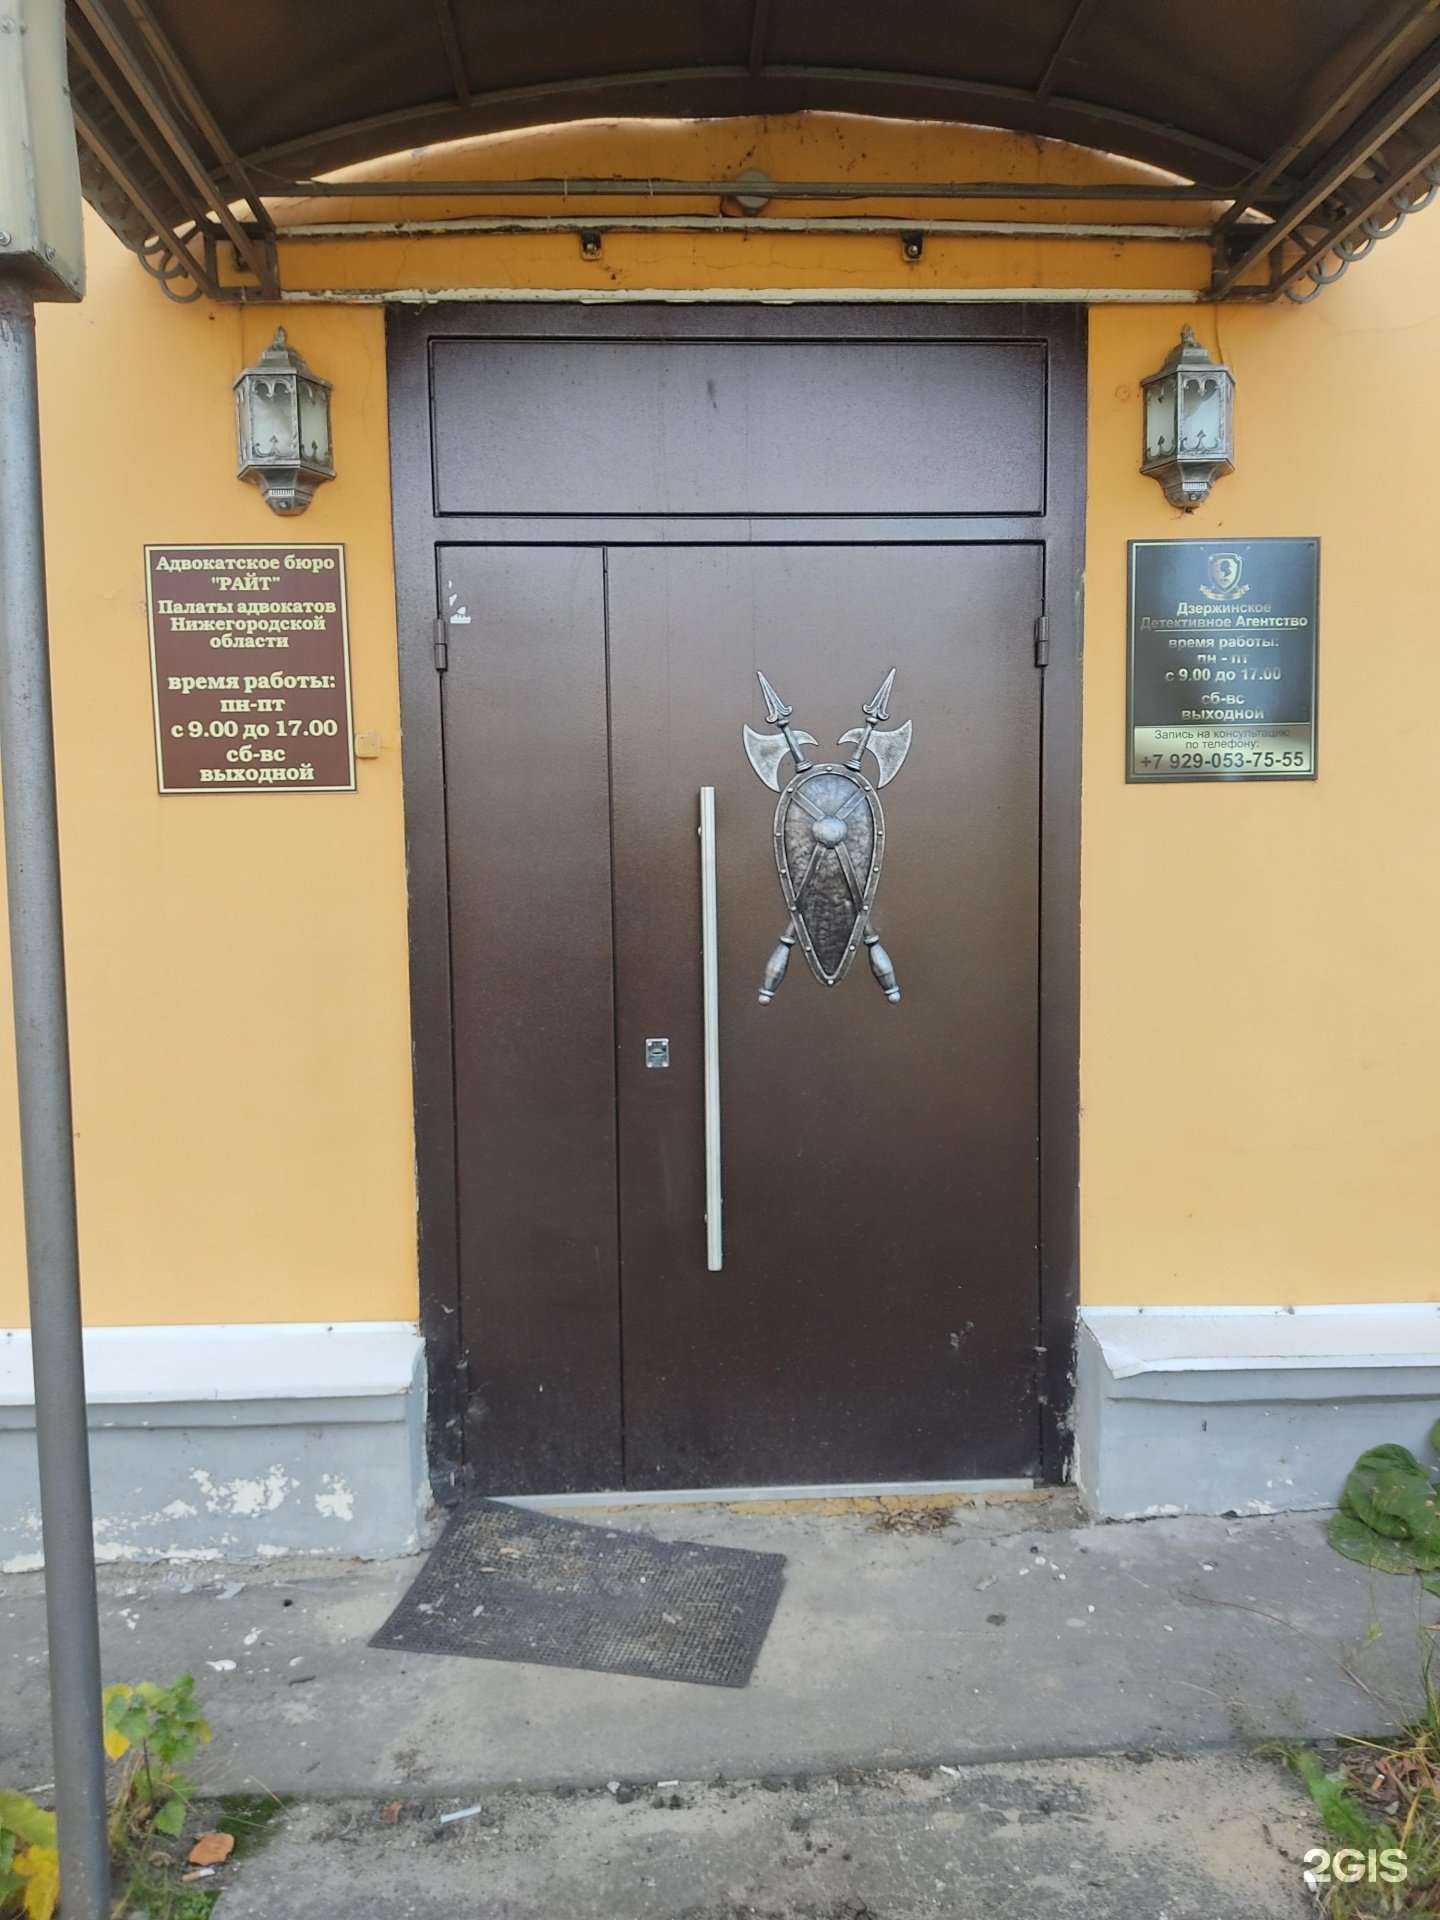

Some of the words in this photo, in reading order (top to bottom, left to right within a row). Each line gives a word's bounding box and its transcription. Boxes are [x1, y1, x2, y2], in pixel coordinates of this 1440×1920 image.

[156, 556, 279, 572] Адвокатское
[284, 555, 334, 572] бюро
[212, 573, 280, 590] "РАЙТ"
[158, 600, 233, 614] Палаты
[238, 602, 336, 615] адвокатов
[170, 616, 325, 633] Нижегородской
[1236, 616, 1307, 627] Агентство
[210, 633, 288, 648] области
[168, 676, 239, 693] время
[244, 671, 335, 693] работы:
[1179, 669, 1210, 681] 9.00
[1216, 671, 1235, 683] до
[221, 700, 285, 712] пн-пт
[171, 725, 183, 737] с
[188, 721, 238, 737] 9.00
[243, 724, 269, 738] до
[276, 720, 337, 736] 17.00
[227, 745, 285, 762] сб-вс
[1140, 754, 1163, 769] +7
[1170, 752, 1304, 769] 929-053-75-55
[200, 764, 314, 783] выходной
